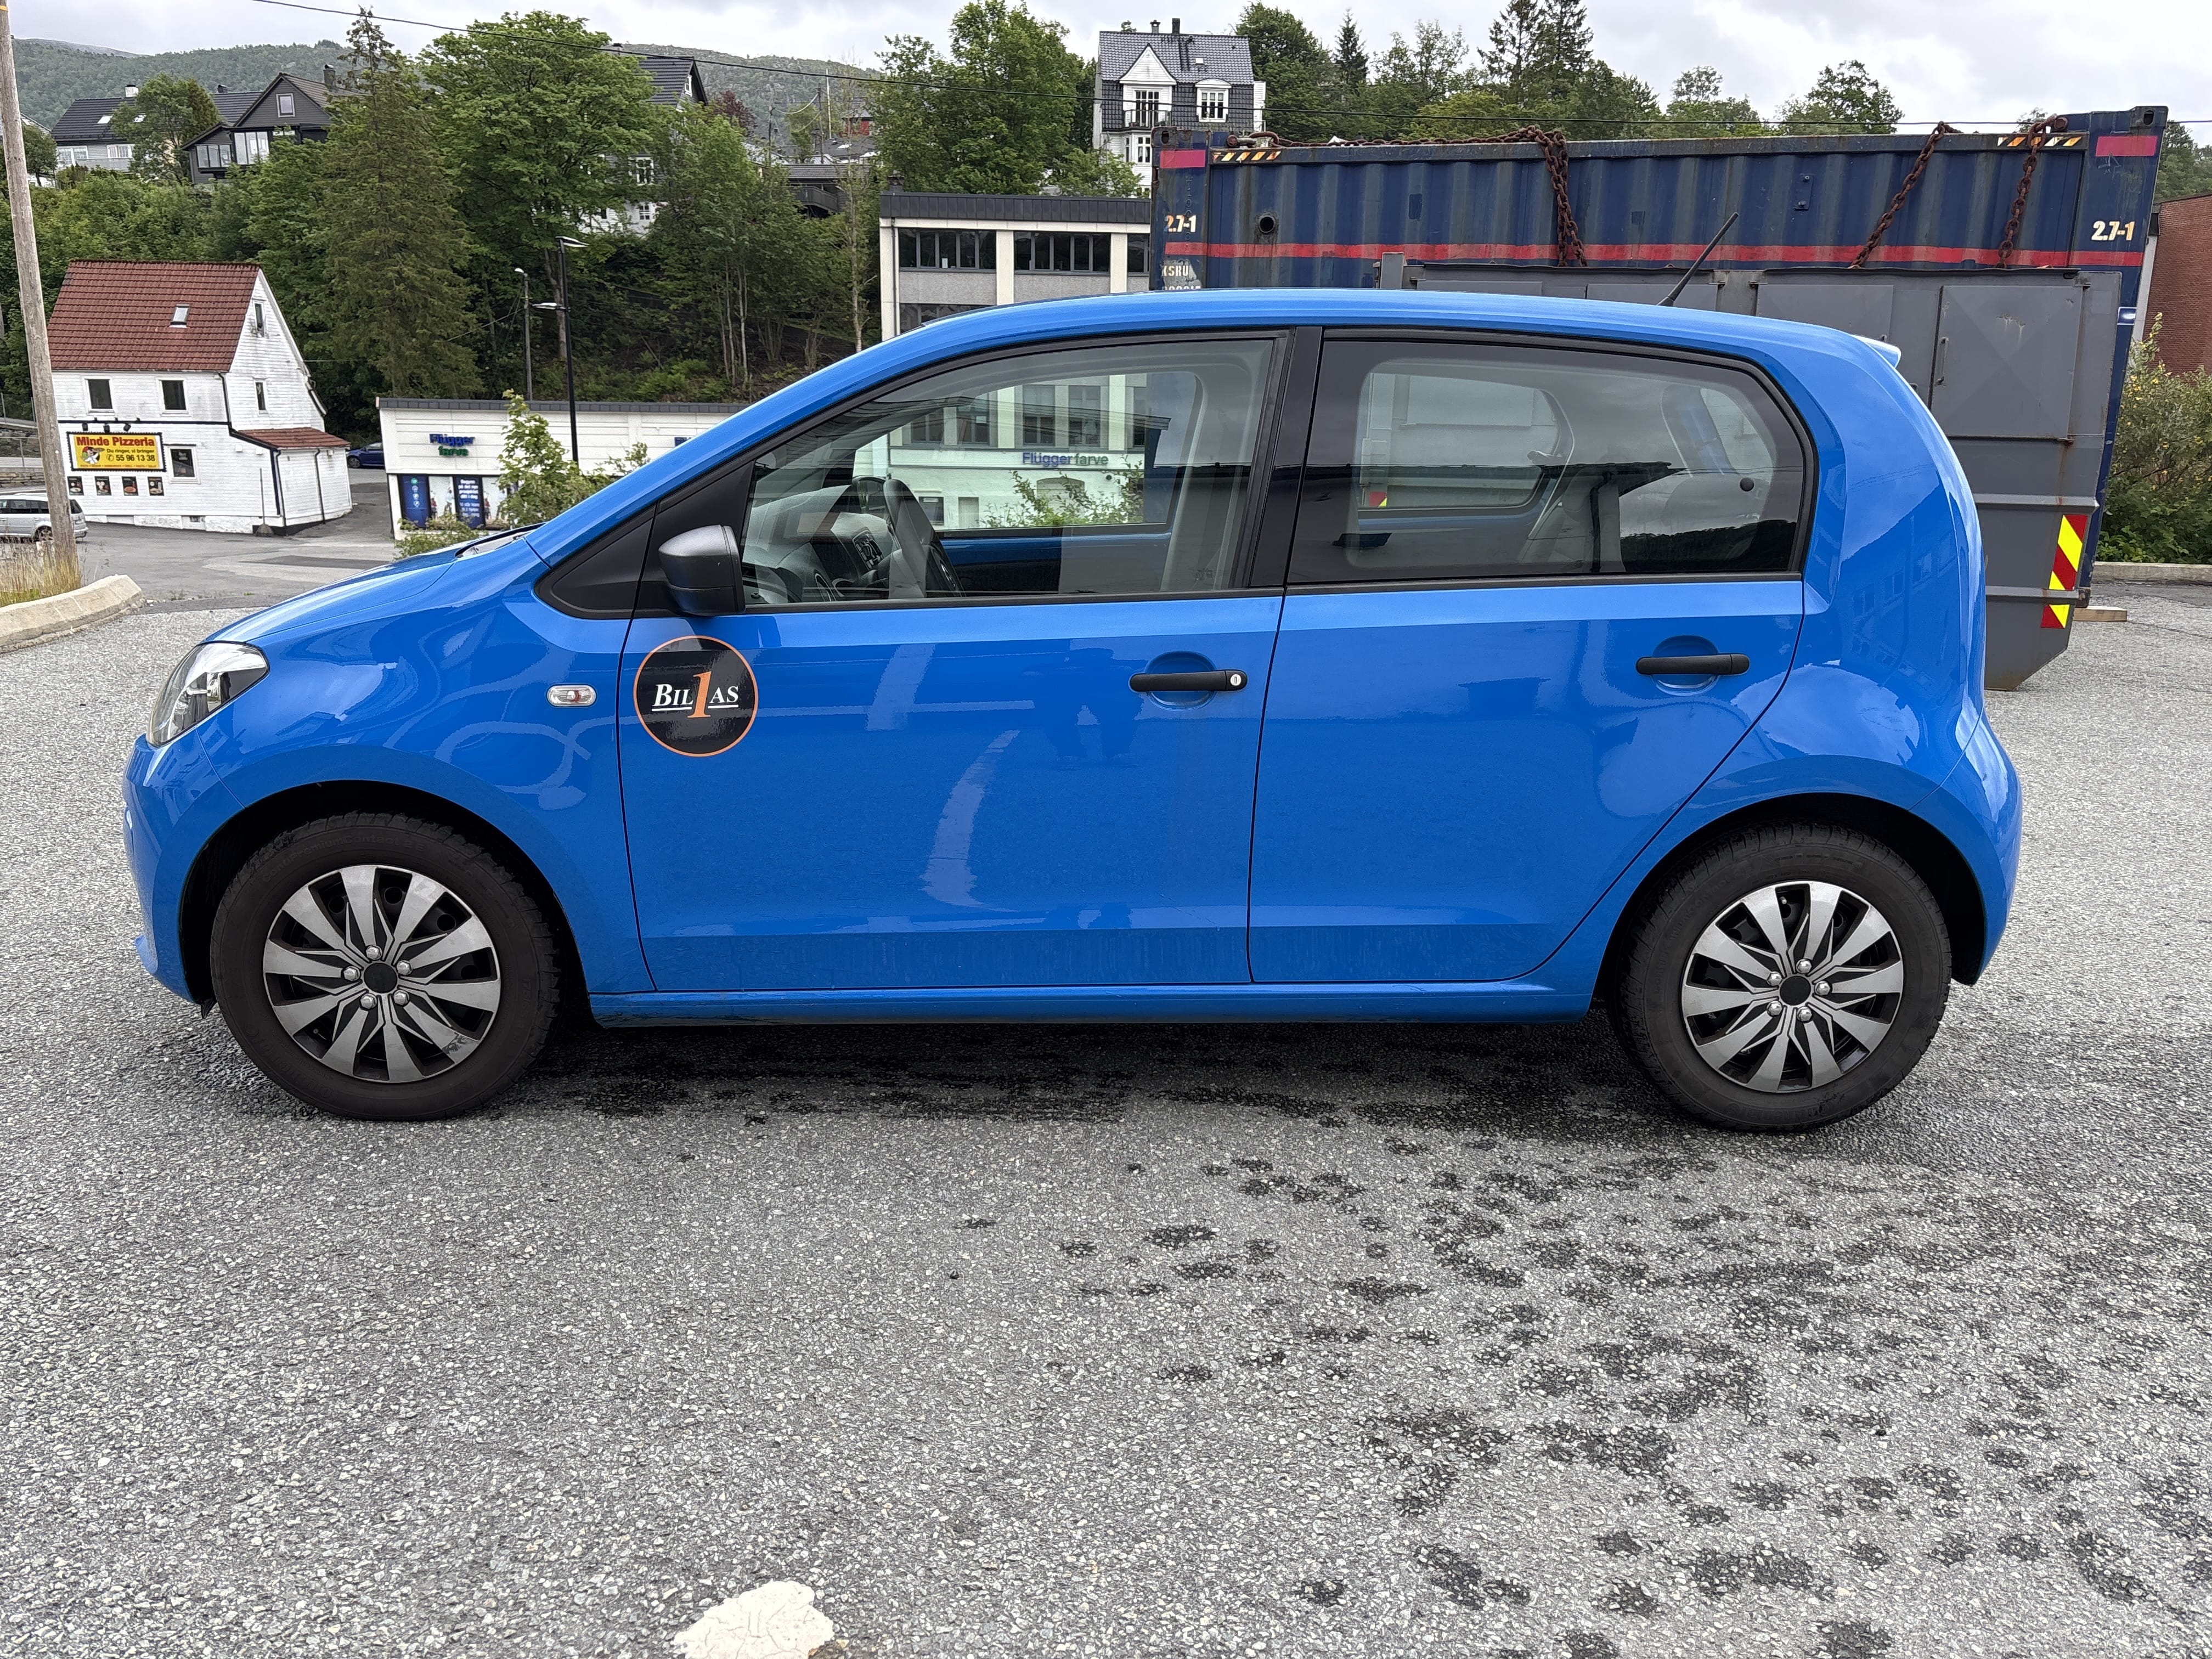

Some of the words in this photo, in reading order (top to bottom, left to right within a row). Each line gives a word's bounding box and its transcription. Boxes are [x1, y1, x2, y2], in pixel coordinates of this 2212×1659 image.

[1164, 215, 1197, 233] 2.7-1
[2091, 221, 2135, 241] 2.7-1
[76, 437, 110, 446] Minde
[112, 437, 155, 447] Pizzeria
[430, 433, 476, 447] Flügger
[438, 446, 469, 456] farve
[1022, 452, 1073, 467] Flügger
[1075, 453, 1109, 465] farve
